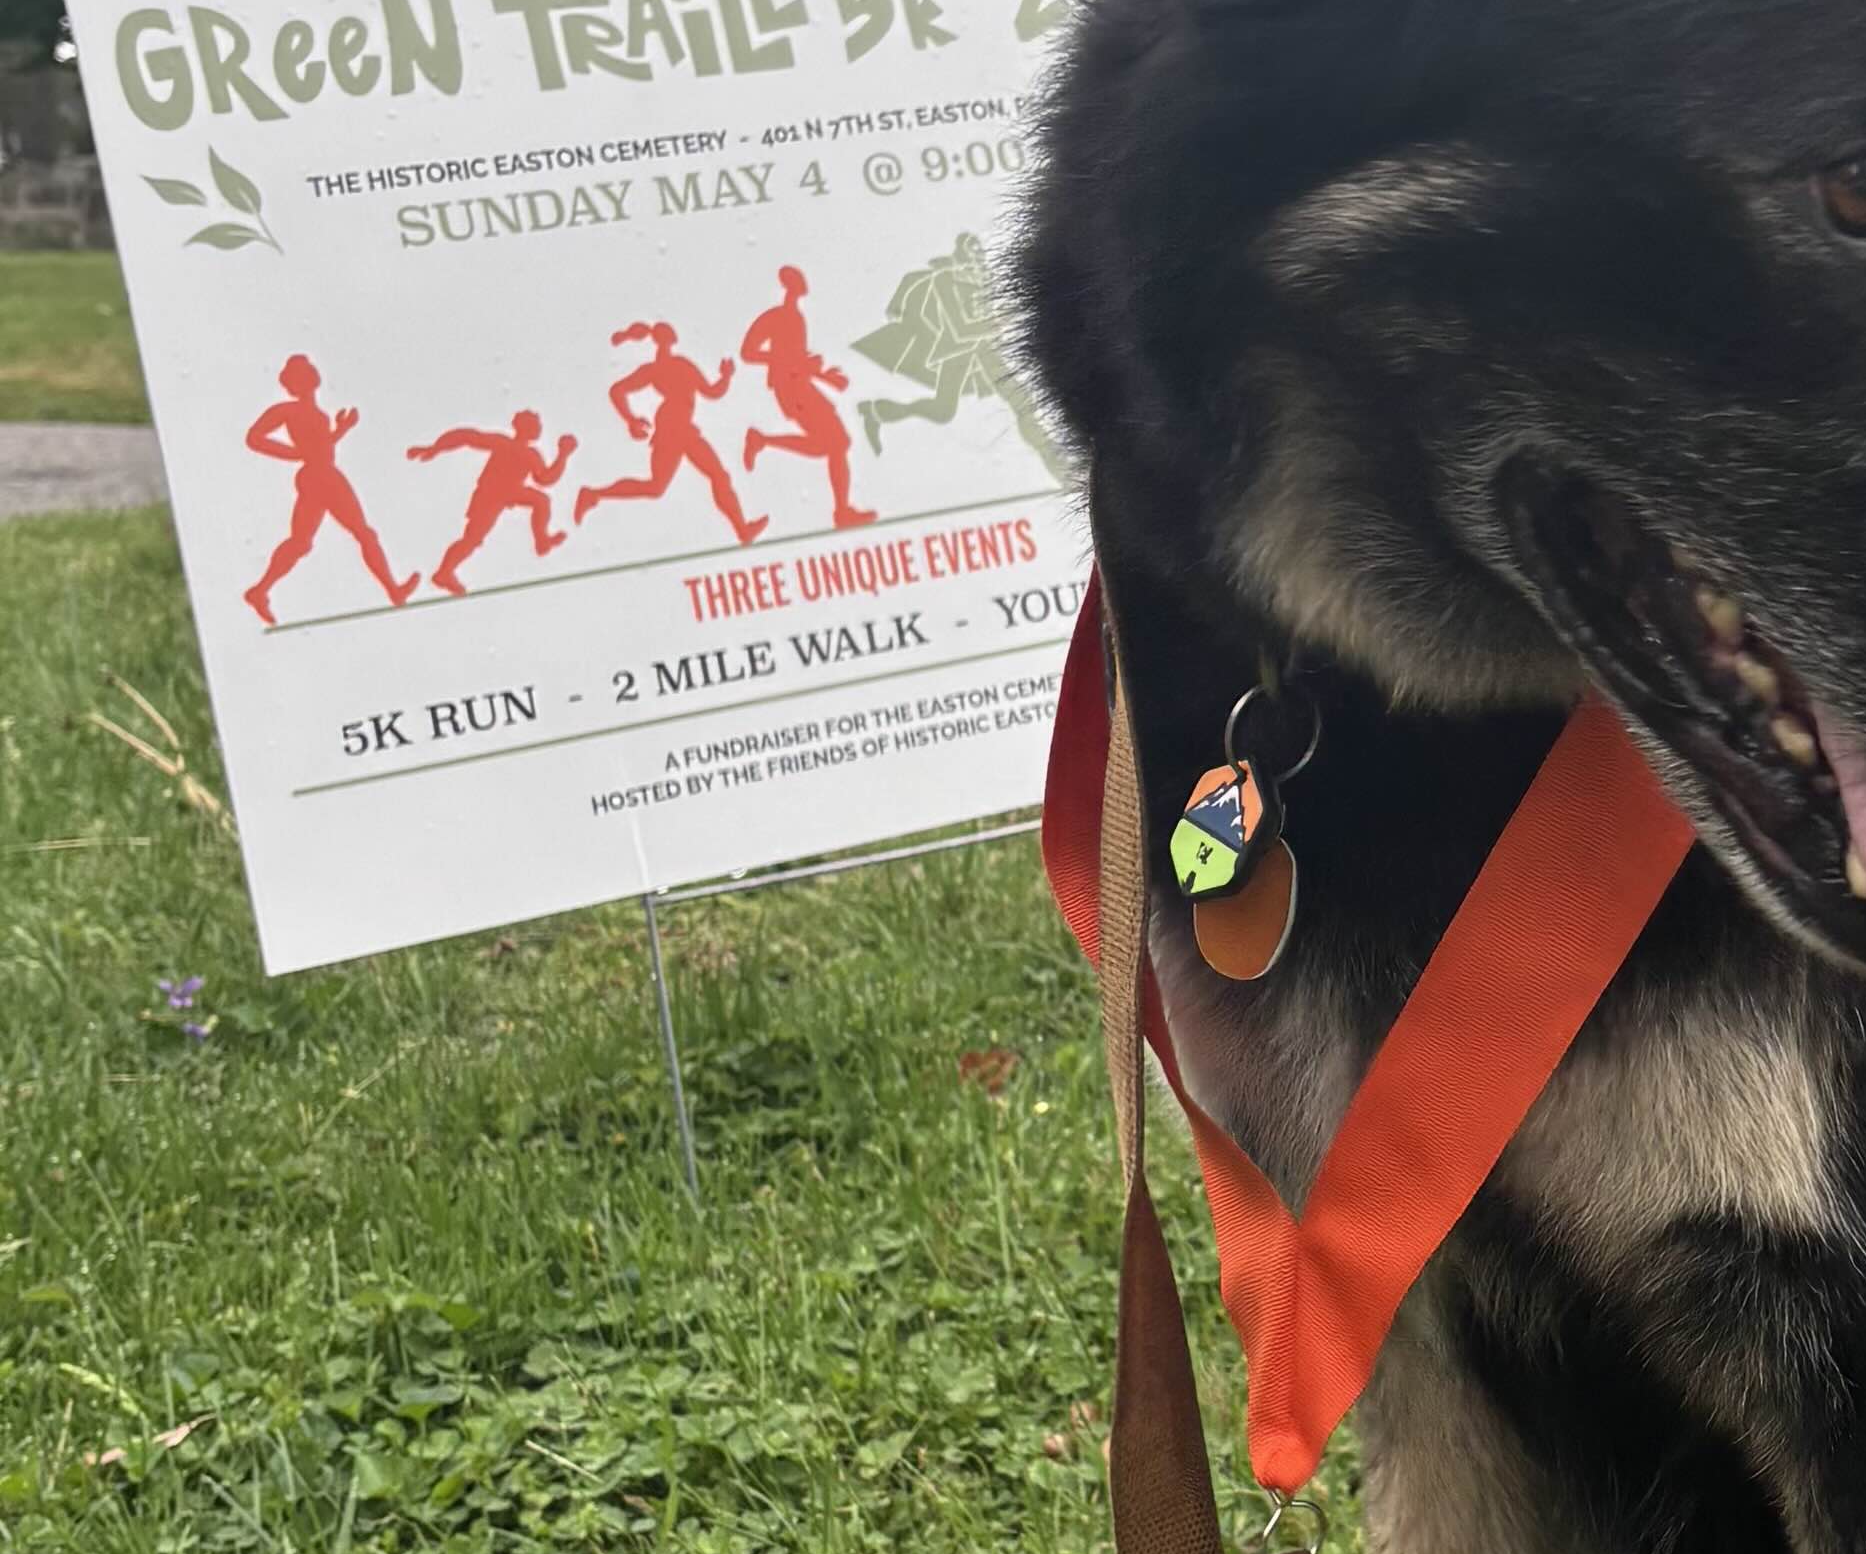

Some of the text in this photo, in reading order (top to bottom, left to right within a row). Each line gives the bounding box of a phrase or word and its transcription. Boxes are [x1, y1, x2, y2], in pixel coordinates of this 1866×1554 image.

[306, 171, 363, 198] THE
[367, 157, 490, 194] HISTORIC
[494, 145, 595, 177] EASTON
[599, 129, 728, 165] CEMETERY
[760, 124, 802, 148] 401
[804, 118, 824, 140] N
[827, 112, 873, 140] 7TH
[397, 137, 1025, 248] SUNDAY MAY 4 @ 9:00
[682, 517, 1039, 623] THREE UNIQUE EVENTS
[340, 709, 414, 757] 5K
[424, 684, 538, 741] RUN
[611, 669, 641, 704] 2
[649, 640, 777, 697] MILE
[787, 611, 932, 668] WALK
[991, 580, 1088, 630] YOU
[590, 778, 682, 817] HOSTED
[686, 771, 715, 796] BY
[717, 760, 763, 788] THE
[766, 741, 858, 778] FRIENDS
[861, 731, 891, 758] OF
[894, 712, 991, 753] HISTORIC
[664, 673, 1063, 773] A FUNDRAISER FOR THE EASTON CEME
